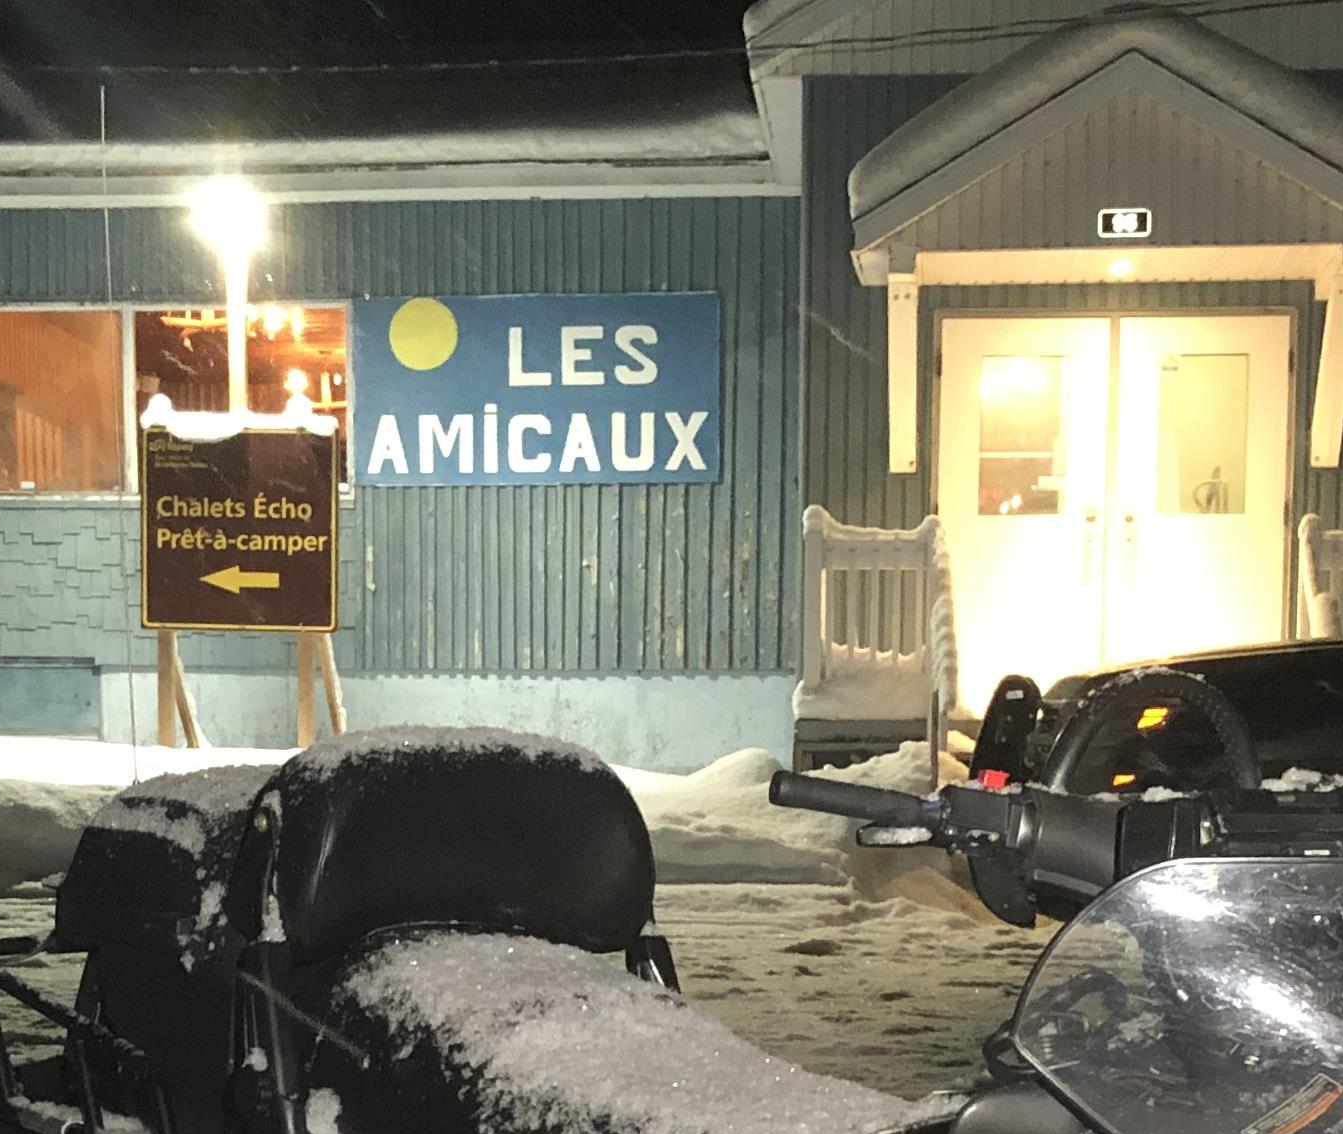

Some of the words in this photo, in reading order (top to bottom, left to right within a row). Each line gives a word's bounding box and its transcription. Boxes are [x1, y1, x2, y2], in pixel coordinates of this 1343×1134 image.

[508, 325, 658, 387] LES
[156, 494, 246, 518] Chalets
[253, 492, 313, 519] Écho
[156, 527, 329, 556] Prêt-à-camper
